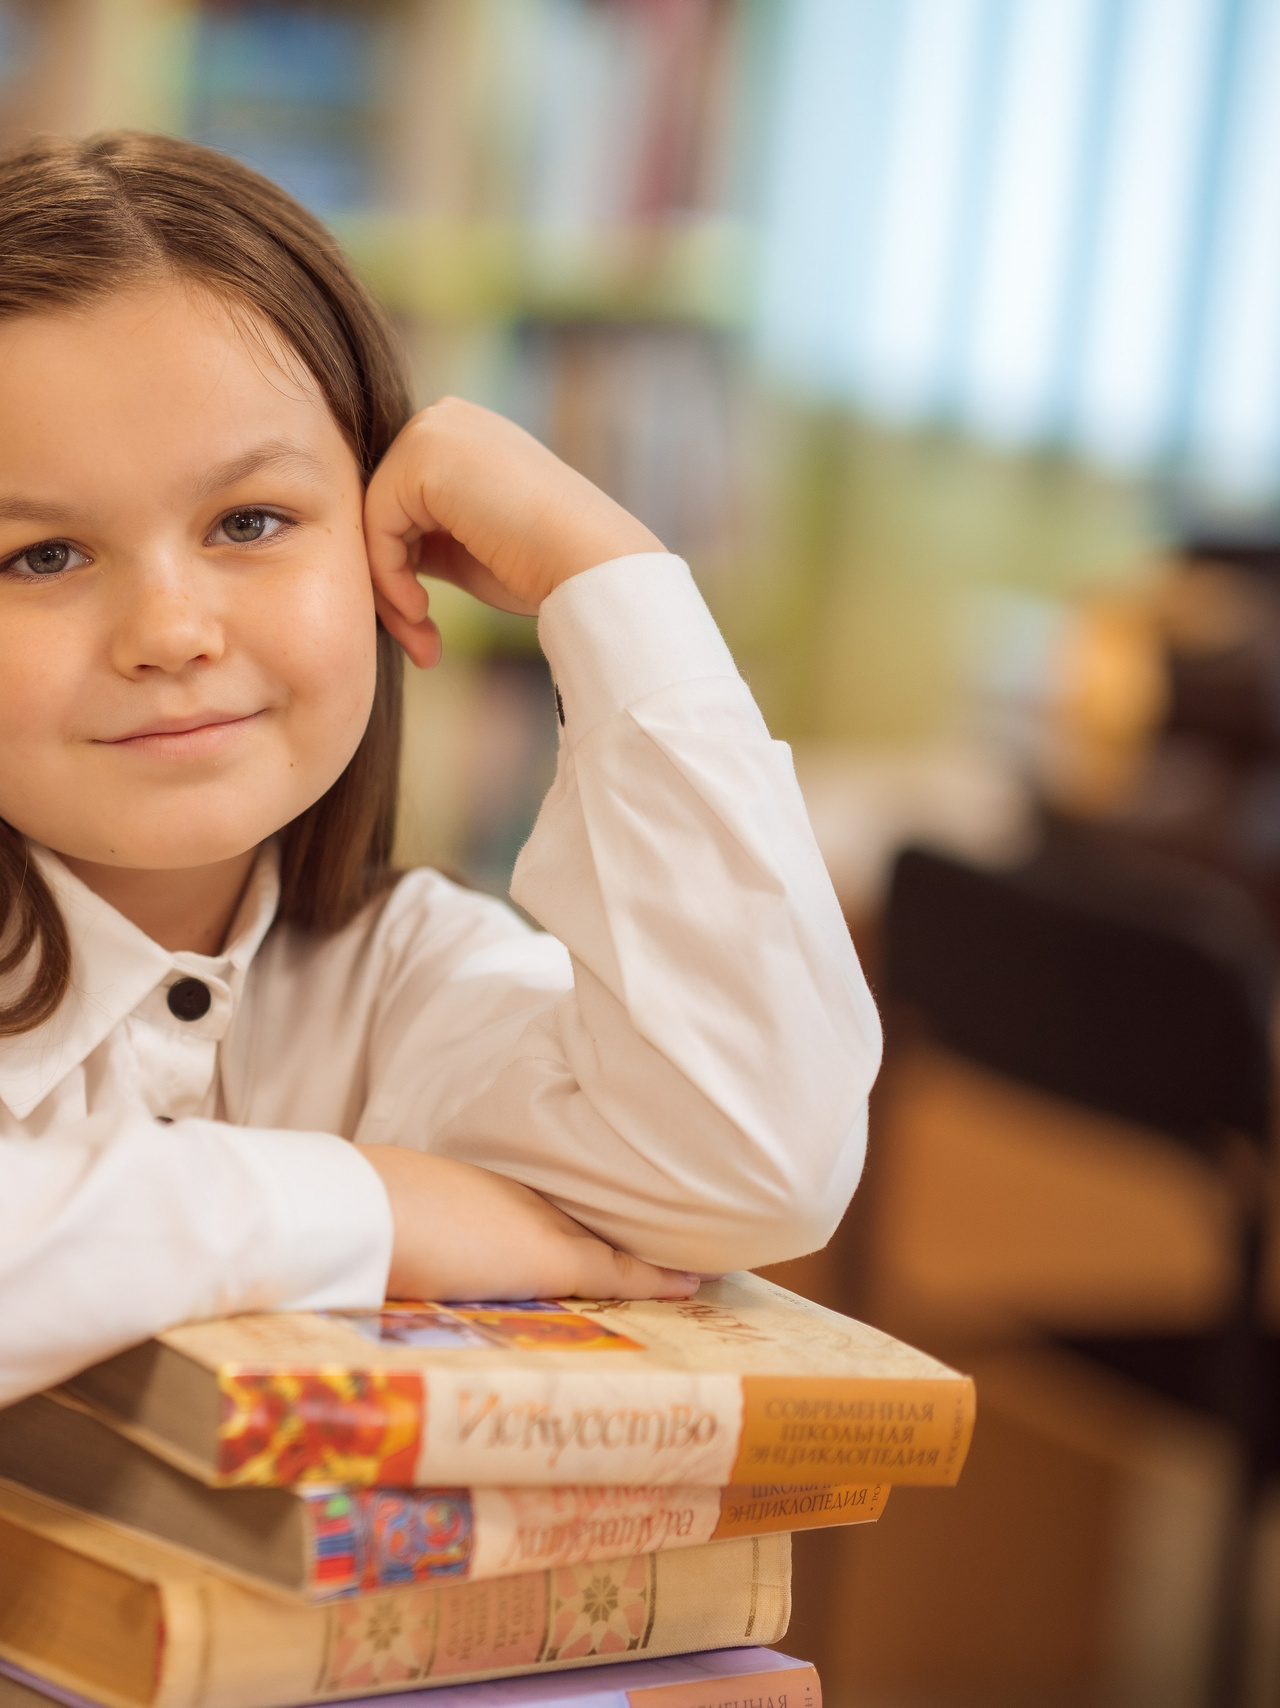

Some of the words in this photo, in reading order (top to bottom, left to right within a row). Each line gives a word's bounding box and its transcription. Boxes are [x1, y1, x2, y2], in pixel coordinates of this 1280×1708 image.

[765, 1400, 935, 1423] СОВРЕМЕННАЯ
[456, 1391, 717, 1468] Искусство
[781, 1424, 915, 1445] ШКОЛЬНАЯ
[750, 1446, 940, 1468] ЭНЦИКЛОПЕДИЯ
[751, 1483, 848, 1499] ШКОЛ
[727, 1488, 869, 1524] ЭНЦИКЛОПЕДИЯ
